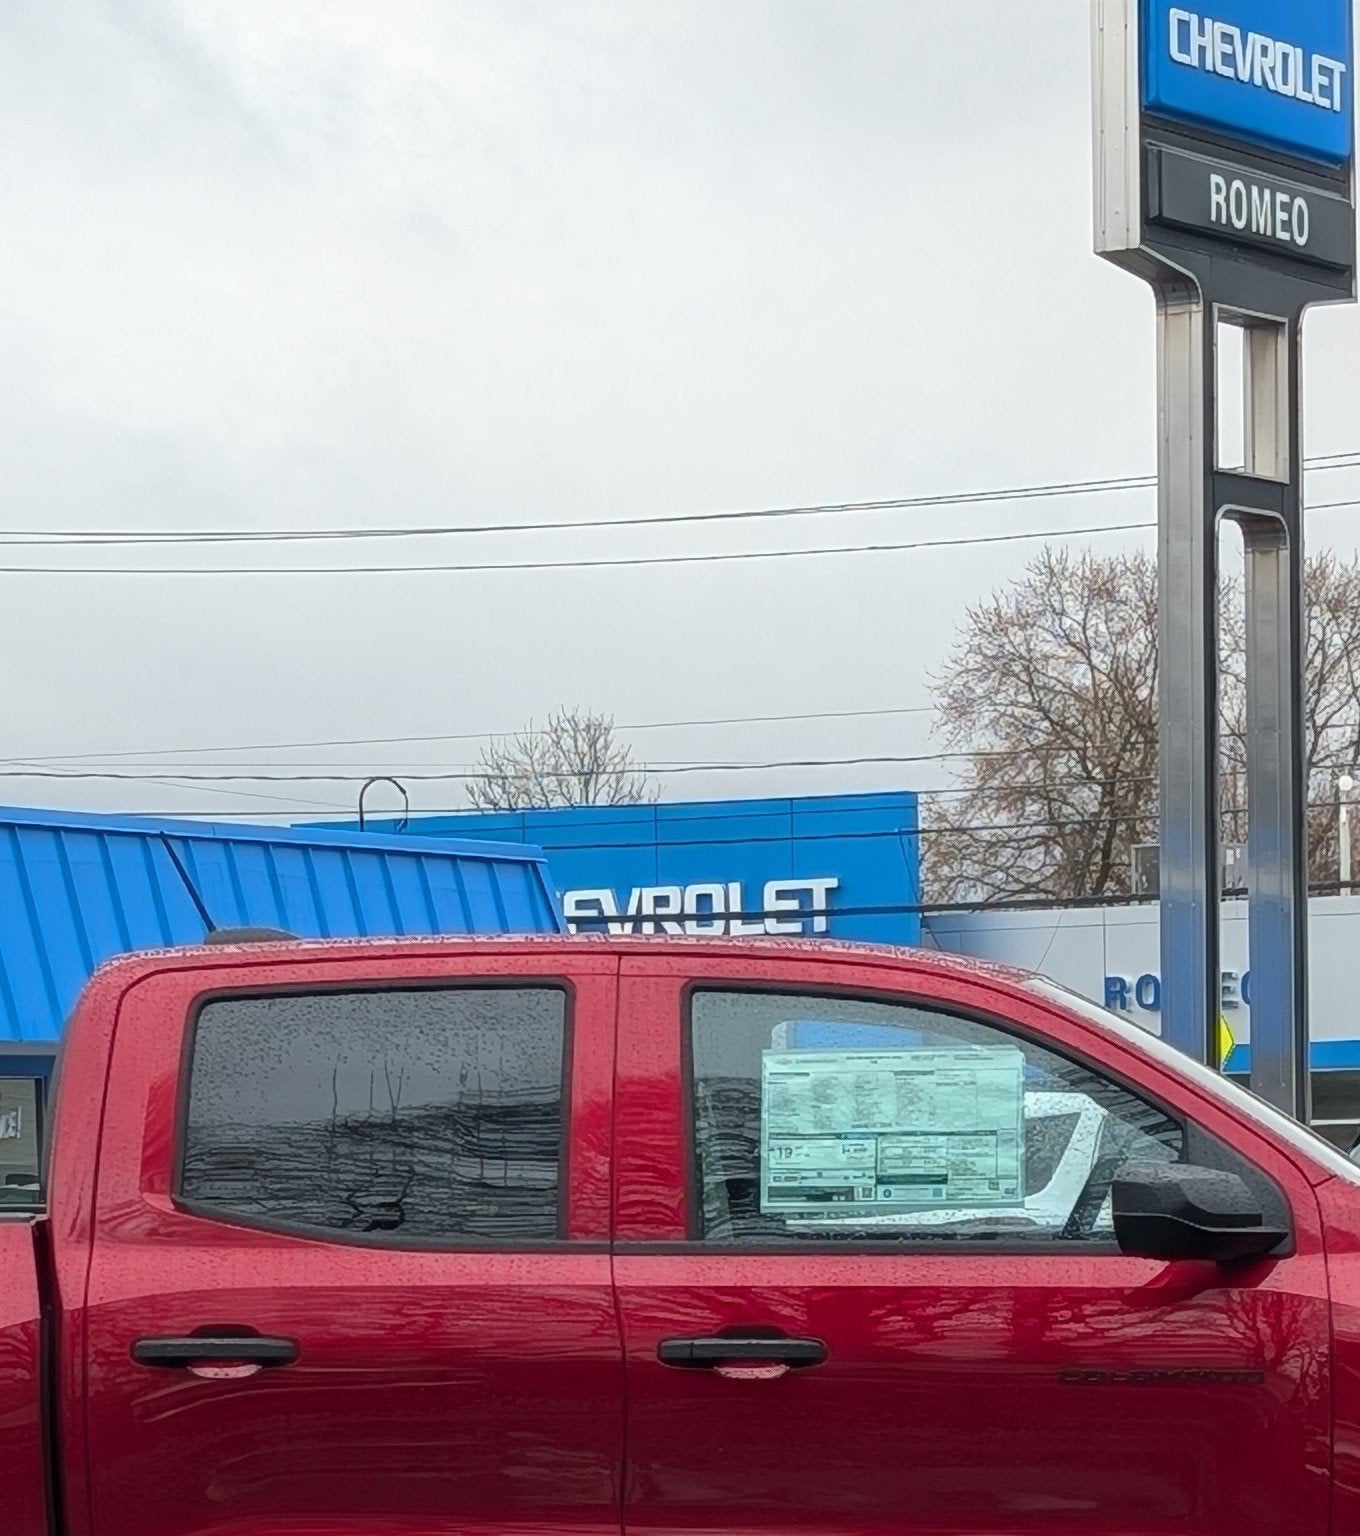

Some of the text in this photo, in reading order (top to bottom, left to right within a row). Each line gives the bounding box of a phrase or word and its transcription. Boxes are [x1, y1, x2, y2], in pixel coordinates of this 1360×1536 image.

[1169, 8, 1346, 112] CHEVROLET
[1210, 174, 1309, 246] ROMEO
[562, 877, 839, 936] EVROLET
